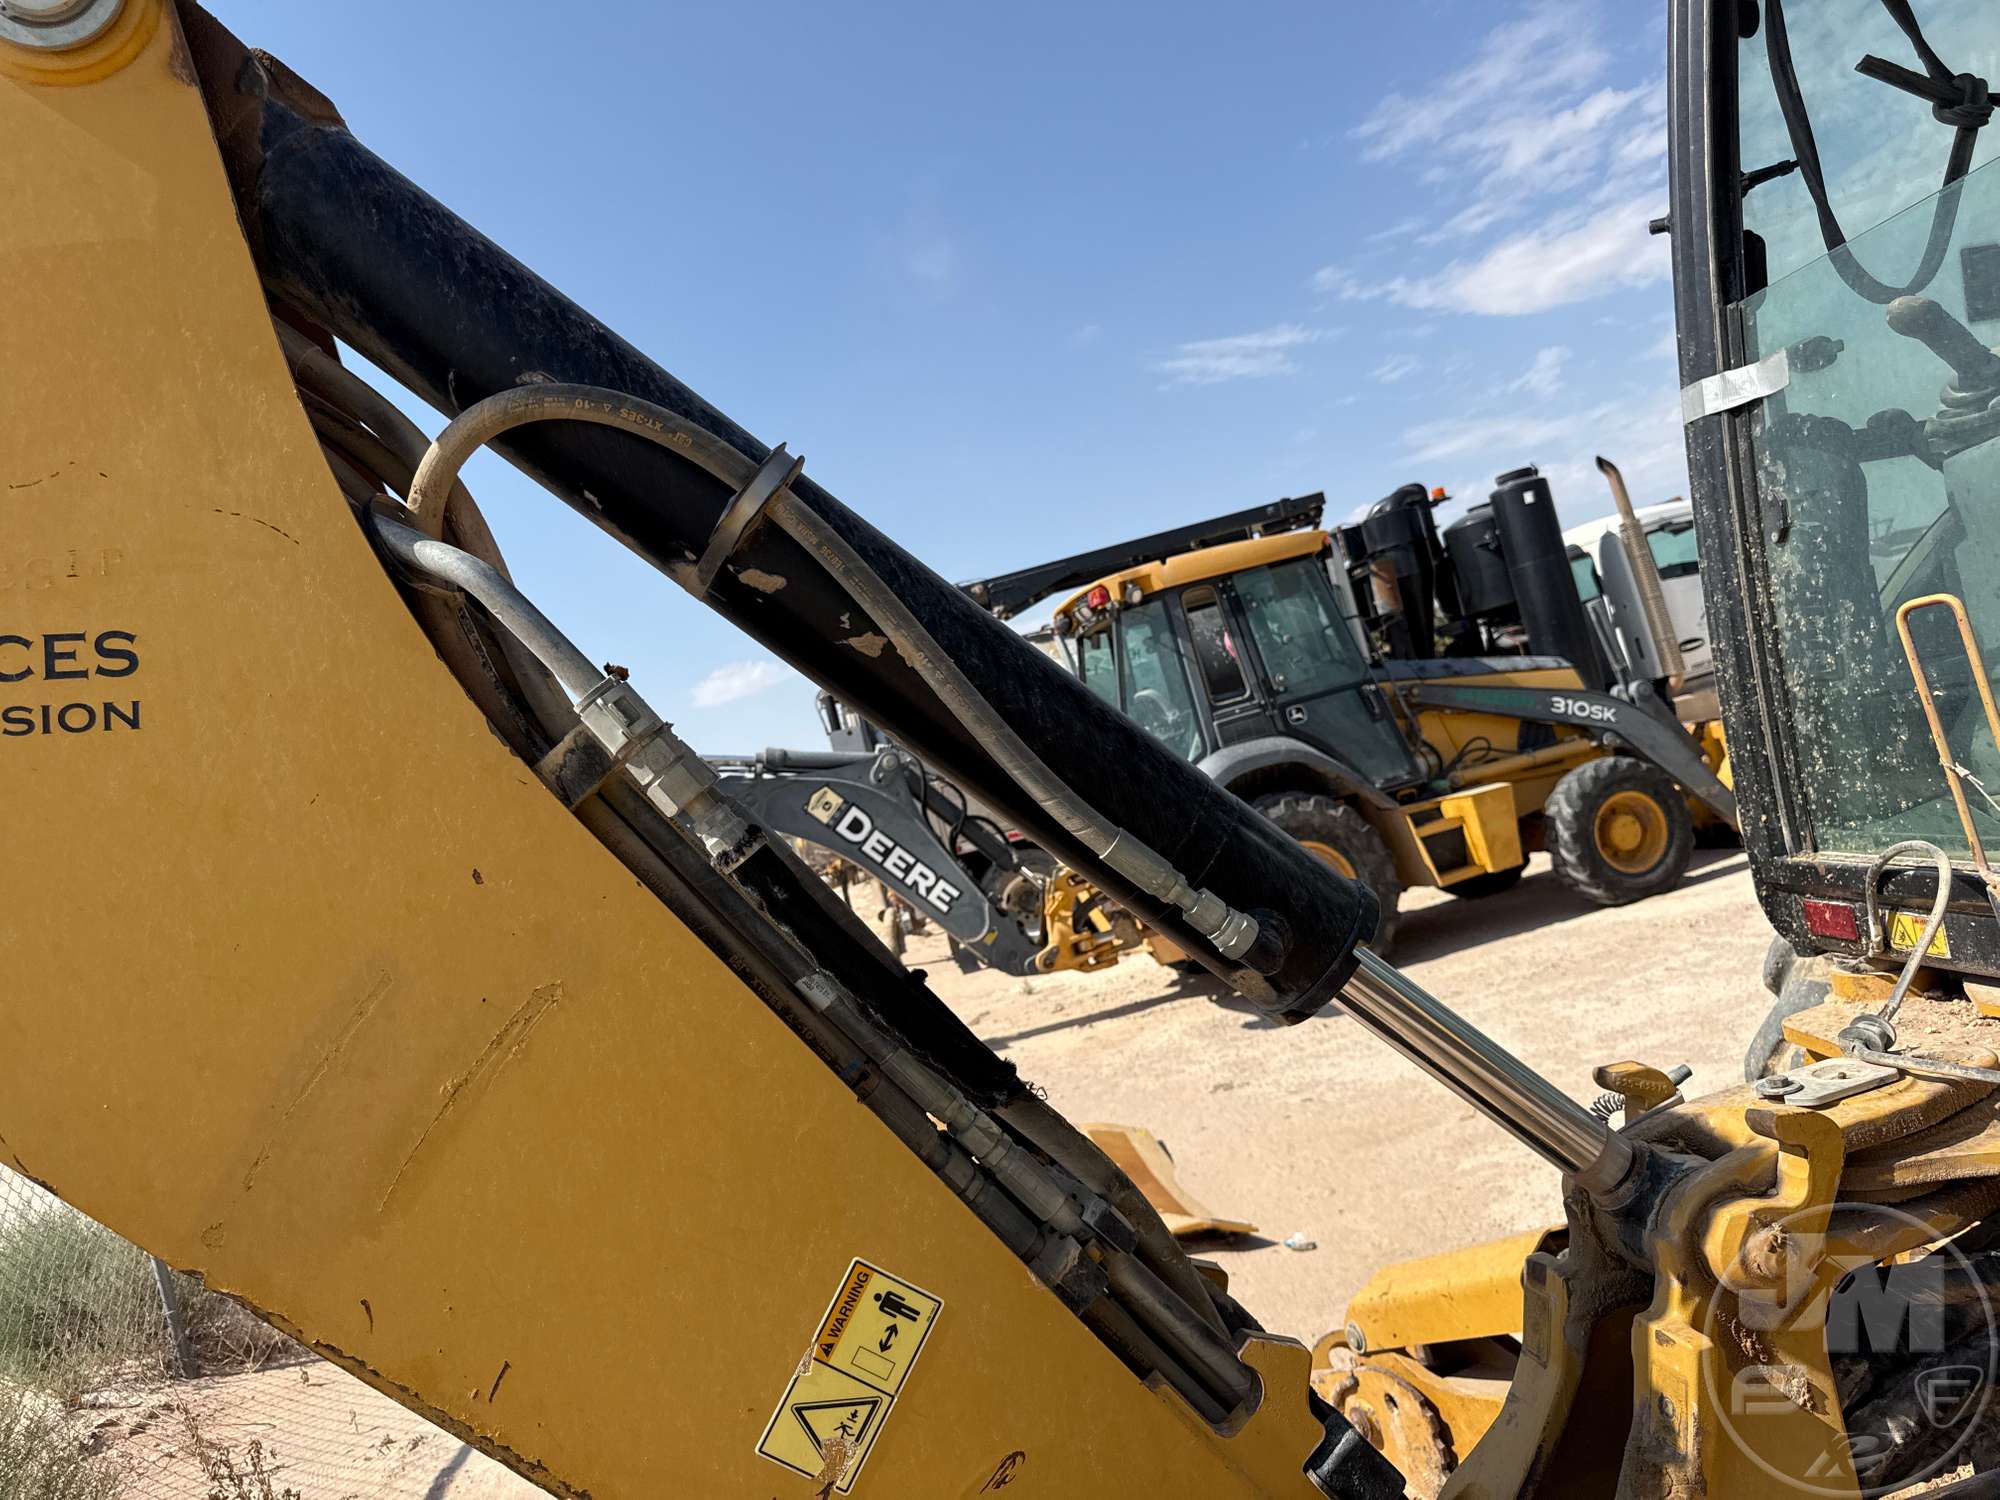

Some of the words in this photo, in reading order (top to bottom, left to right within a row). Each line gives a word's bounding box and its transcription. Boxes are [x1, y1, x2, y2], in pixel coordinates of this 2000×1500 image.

[619, 408, 664, 432] XT-3ES
[0, 630, 140, 682] CES
[1, 700, 142, 737] SION
[1550, 696, 1617, 723] 310SK
[834, 805, 961, 913] DEERE
[827, 1270, 870, 1339] WARNING
